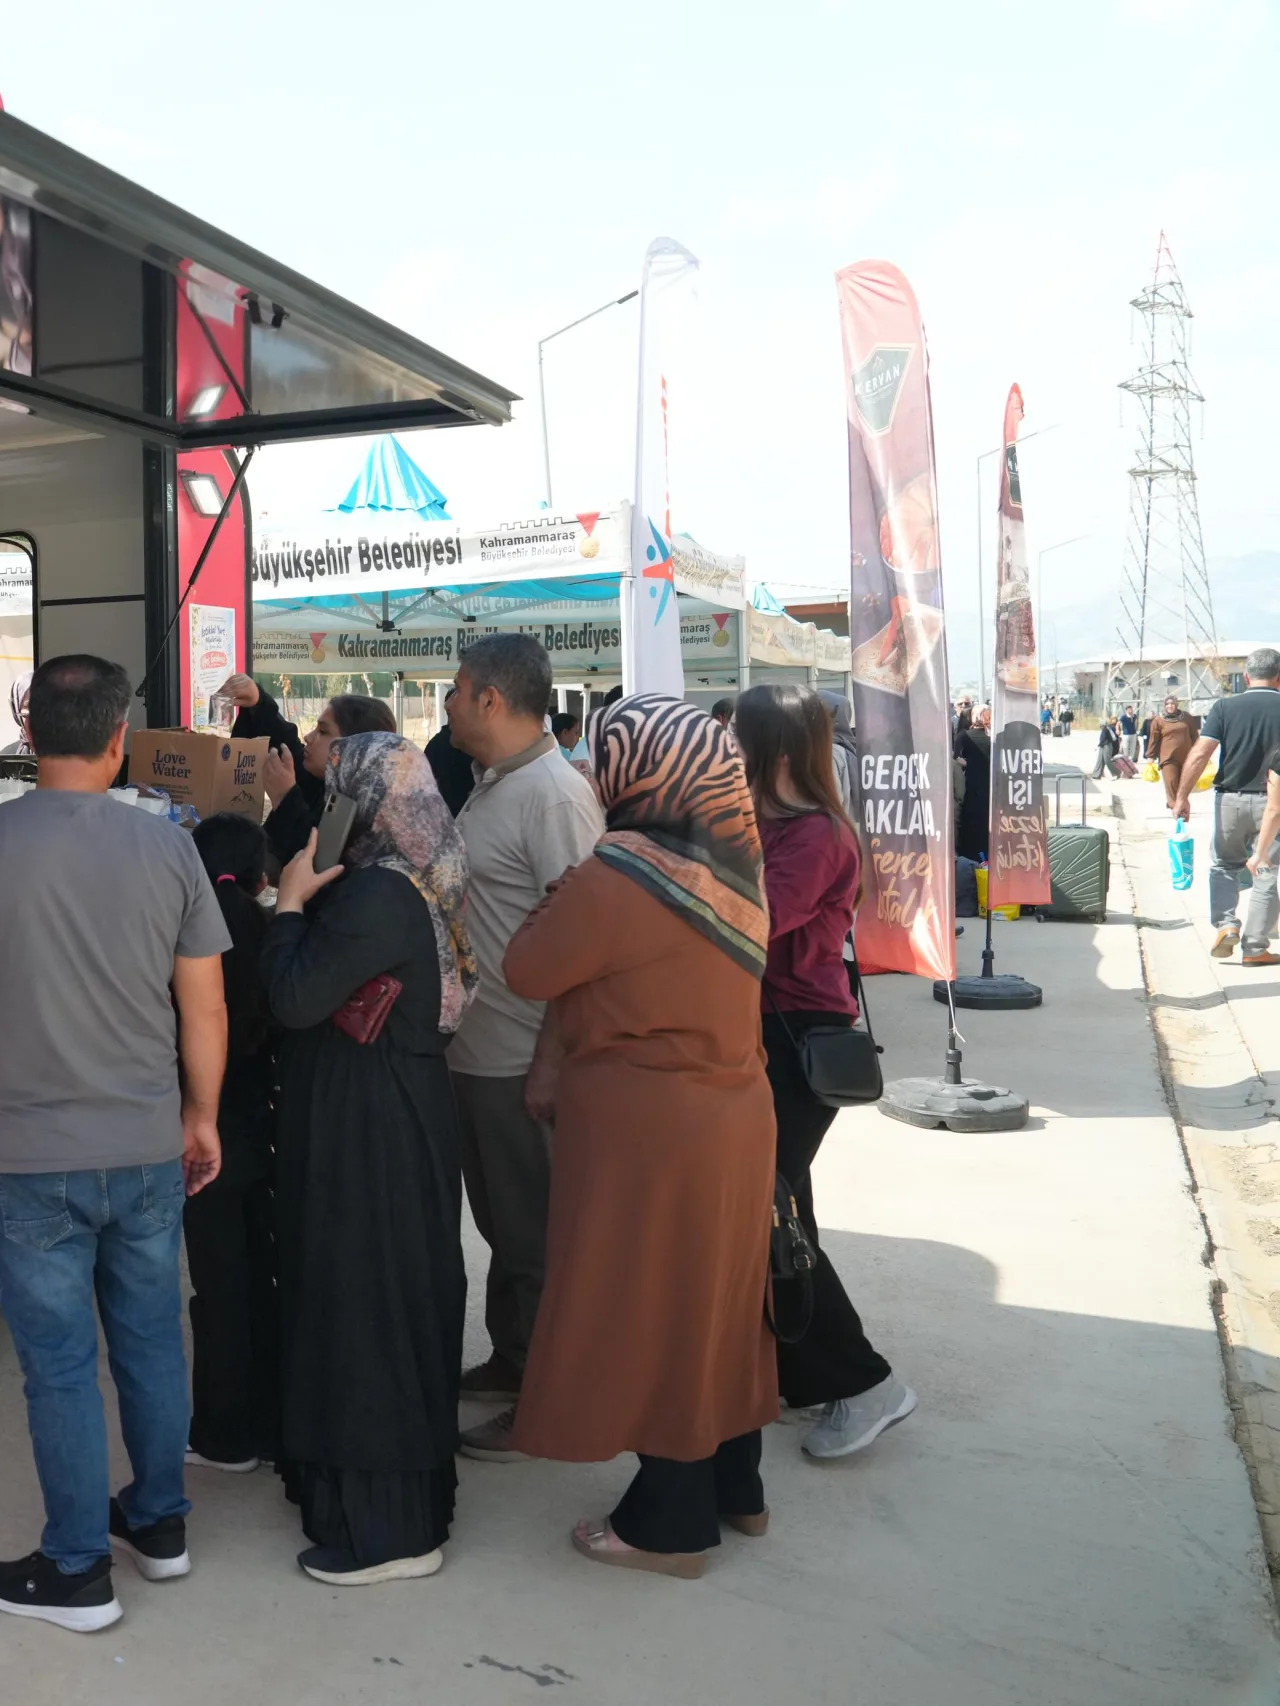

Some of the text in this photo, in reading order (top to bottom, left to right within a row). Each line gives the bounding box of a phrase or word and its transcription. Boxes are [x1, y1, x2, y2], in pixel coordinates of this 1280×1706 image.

[480, 531, 576, 549] Kahramanmaraş
[358, 527, 463, 576] Belediyesi
[481, 544, 576, 562] Büyükşehir Belediyesi
[252, 641, 309, 651] ahramanmaraş
[338, 633, 452, 661] Kahramanmaraş
[279, 651, 310, 661] Belediyesi
[156, 749, 186, 765] Love
[237, 751, 256, 768] Love
[152, 763, 191, 779] Water
[234, 769, 256, 785] Water
[861, 752, 931, 798] GERÇK
